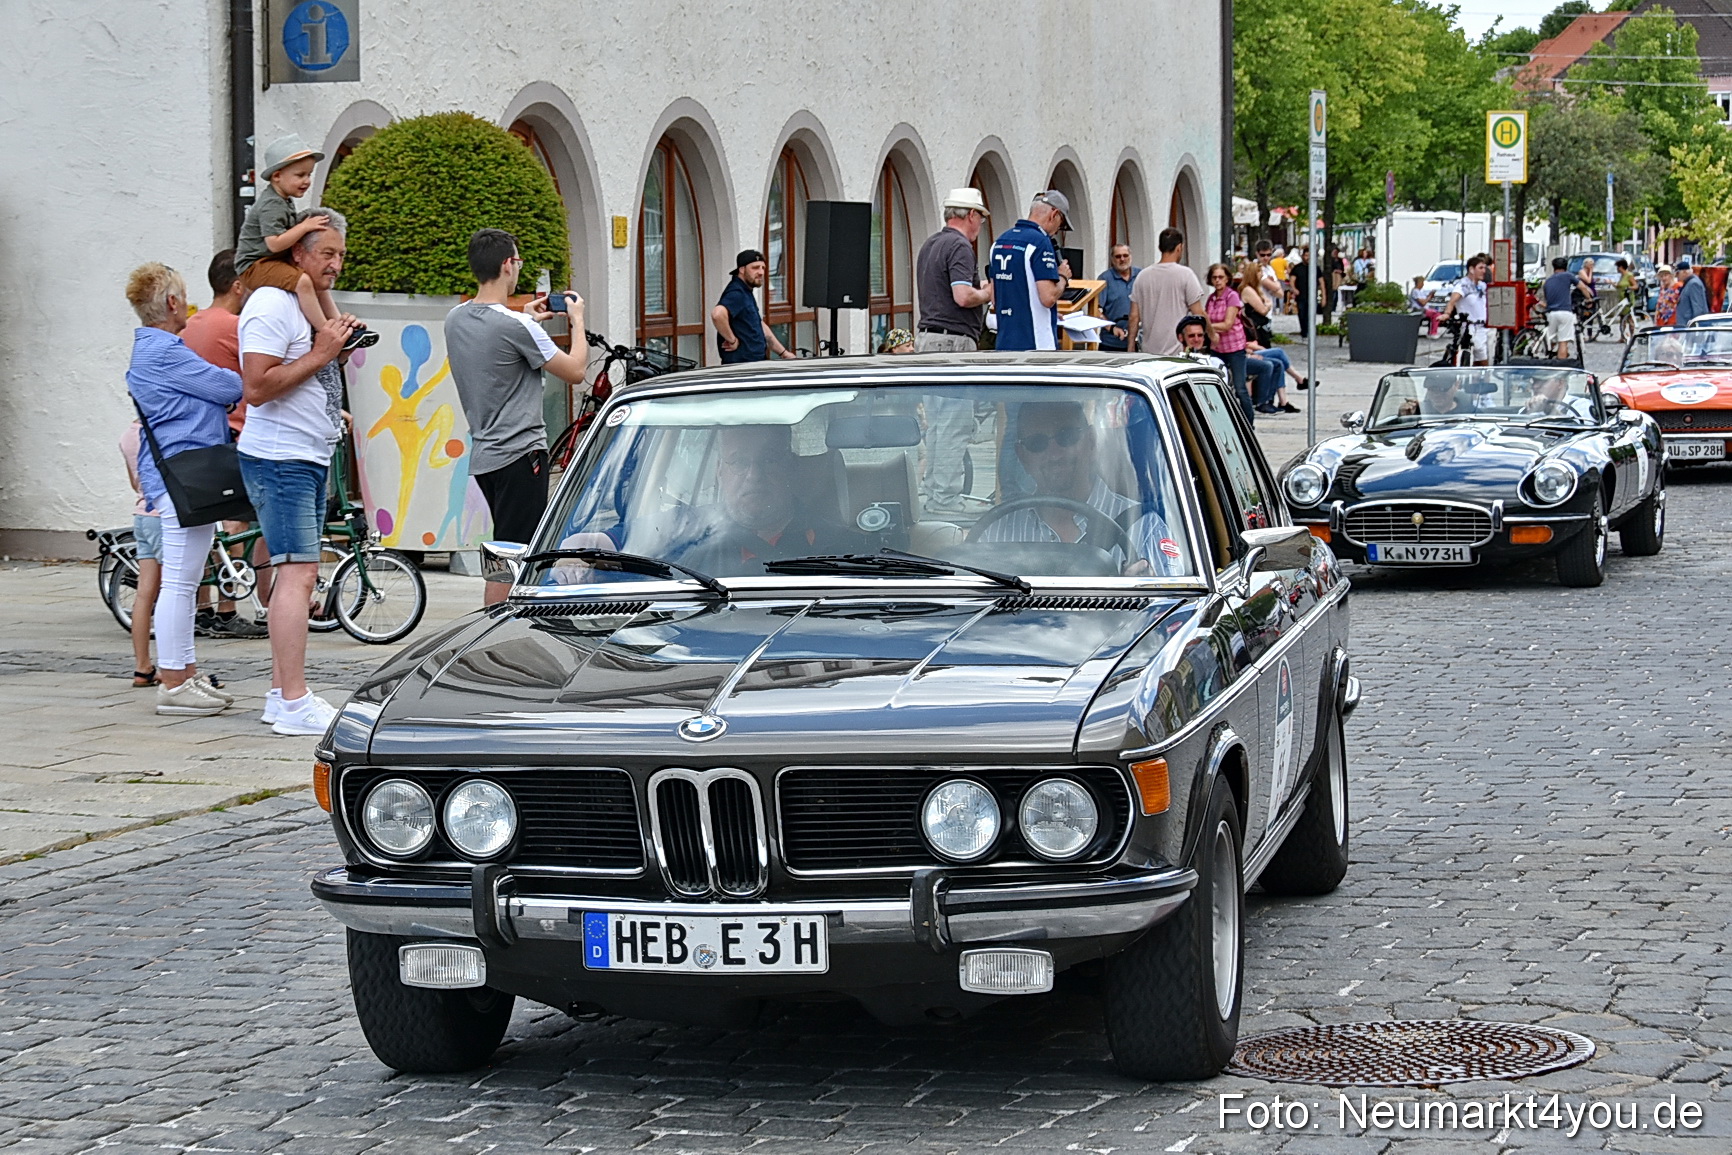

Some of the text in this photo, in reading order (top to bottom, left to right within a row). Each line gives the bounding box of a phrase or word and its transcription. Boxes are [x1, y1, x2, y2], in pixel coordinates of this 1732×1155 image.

[1501, 123, 1512, 141] H
[1688, 445, 1701, 456] SP
[1704, 445, 1723, 456] 28H
[1383, 547, 1395, 560] K
[1405, 547, 1417, 560] N
[1419, 547, 1464, 561] 973H
[615, 920, 689, 965] HEB
[721, 922, 746, 966] E
[757, 922, 781, 965] 3
[793, 922, 819, 965] H
[593, 946, 602, 958] D
